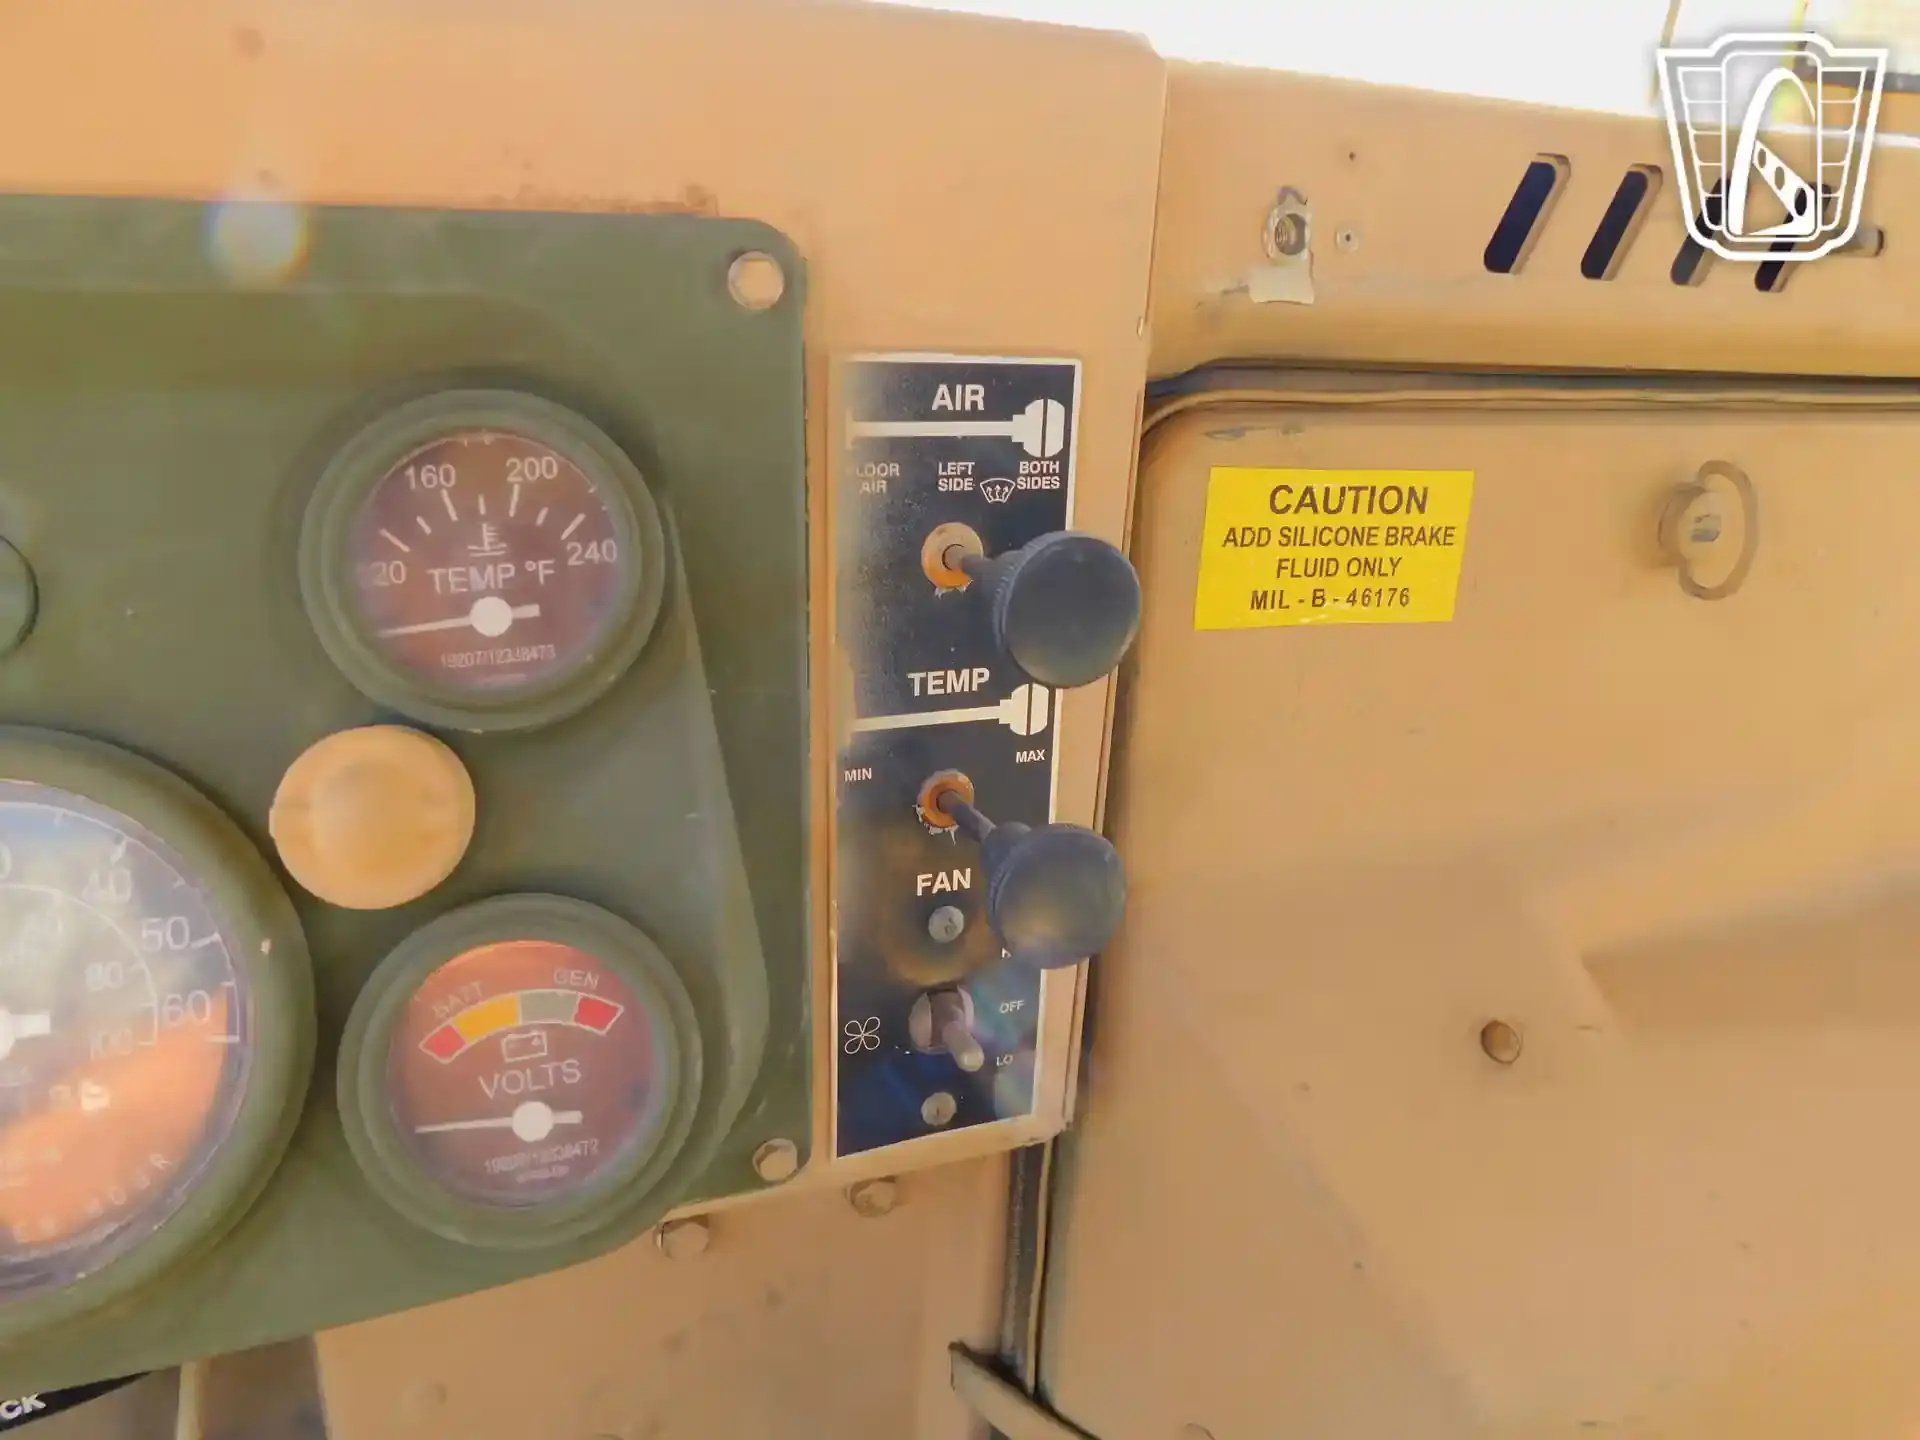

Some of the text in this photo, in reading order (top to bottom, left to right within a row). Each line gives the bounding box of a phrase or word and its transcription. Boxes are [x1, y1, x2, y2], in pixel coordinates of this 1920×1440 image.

[931, 383, 986, 411] AIR
[405, 464, 456, 490] 160
[505, 456, 558, 482] 200
[855, 462, 900, 478] LOOR
[937, 461, 976, 476] LEFT
[1018, 460, 1060, 475] BOTH
[859, 479, 888, 495] AIR
[937, 477, 974, 492] SIDE
[1016, 475, 1061, 490] SIDES
[1269, 484, 1429, 516] CAUTION
[1222, 526, 1457, 549] ADD SILICONE BRAKE
[566, 538, 618, 567] 240
[365, 560, 407, 588] 20
[427, 559, 556, 594] TEMP °F
[1276, 556, 1403, 579] FLUID ONLY
[1249, 589, 1291, 611] MIL
[1311, 588, 1326, 608] B
[1345, 587, 1411, 608] 46176
[906, 667, 991, 698] TEMP
[1015, 748, 1046, 764] MAX
[844, 767, 873, 782] MIN
[82, 868, 132, 903] 40
[916, 867, 972, 897] FAN
[141, 916, 190, 951] 50
[553, 969, 600, 990] GEN
[162, 989, 212, 1027] 60
[999, 999, 1026, 1014] OFF
[996, 1054, 1014, 1067] LO
[479, 1058, 582, 1100] VOLTS
